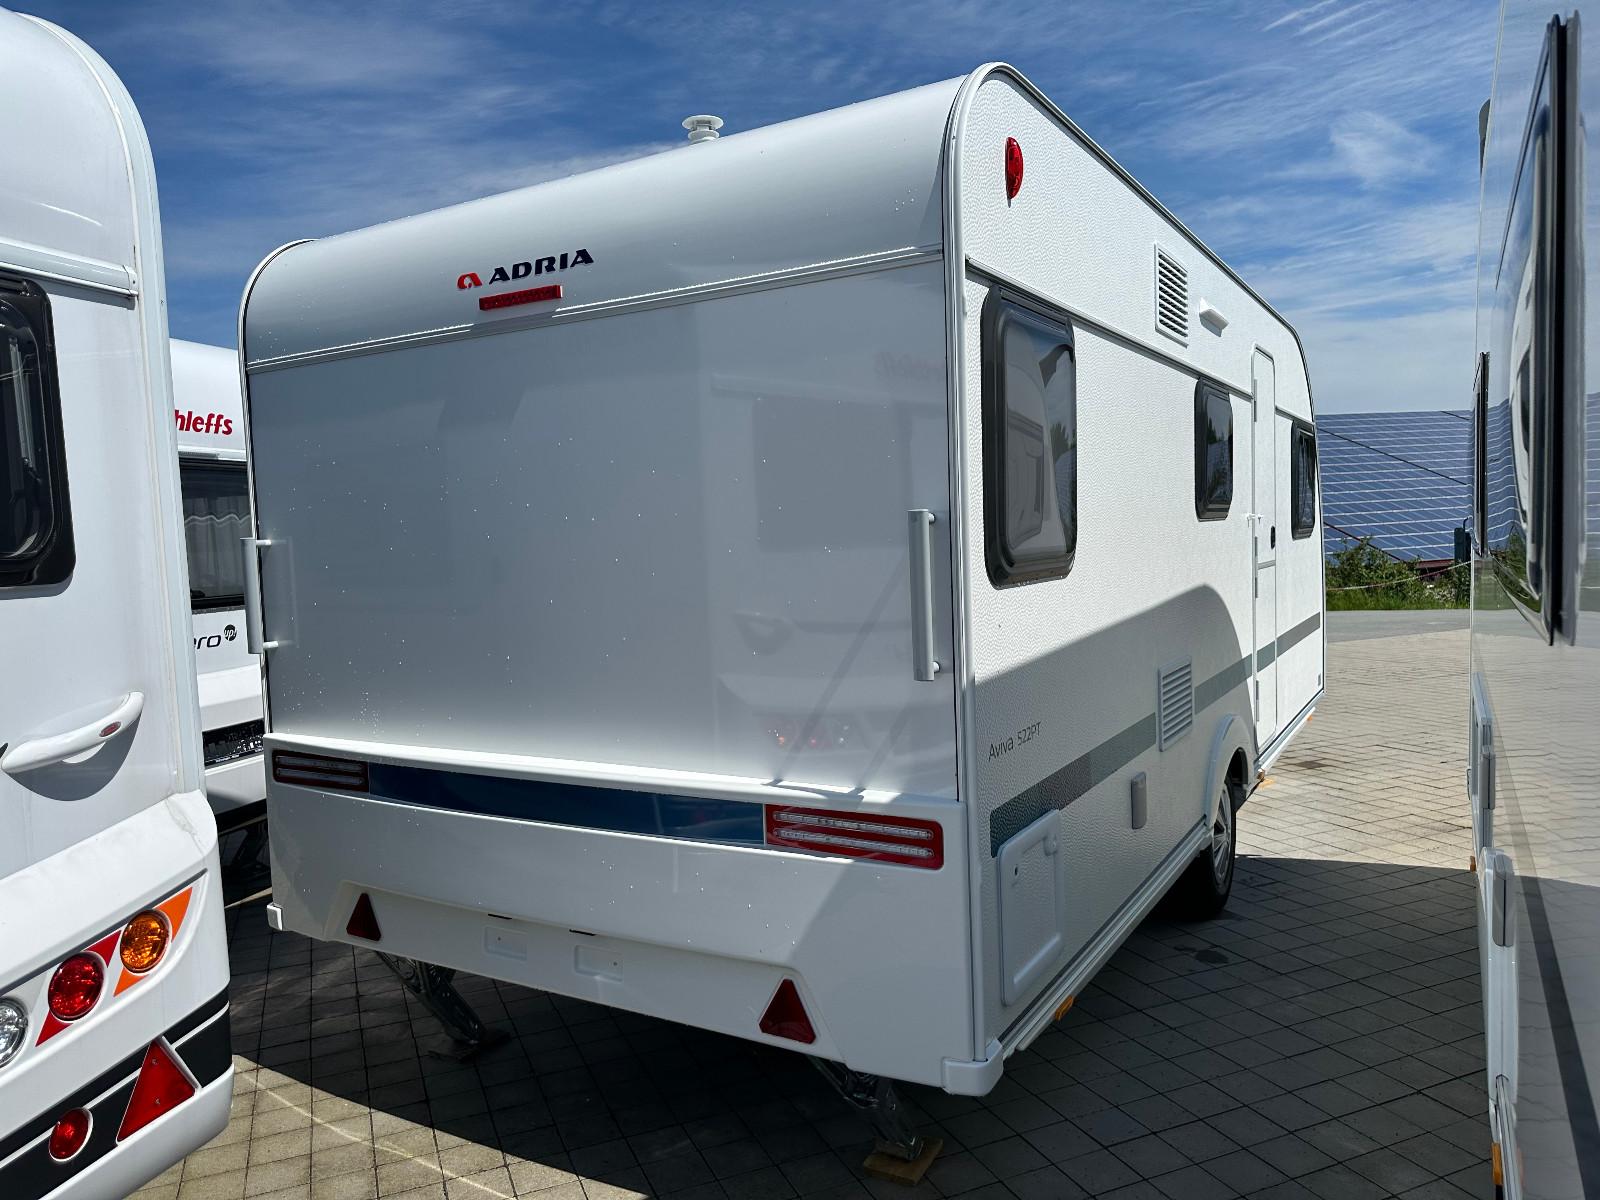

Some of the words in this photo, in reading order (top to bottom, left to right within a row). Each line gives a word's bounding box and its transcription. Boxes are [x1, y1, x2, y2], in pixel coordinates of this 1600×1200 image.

[489, 248, 594, 285] ADRIA
[988, 736, 1014, 762] Aviva
[1017, 721, 1041, 746] 522PT
